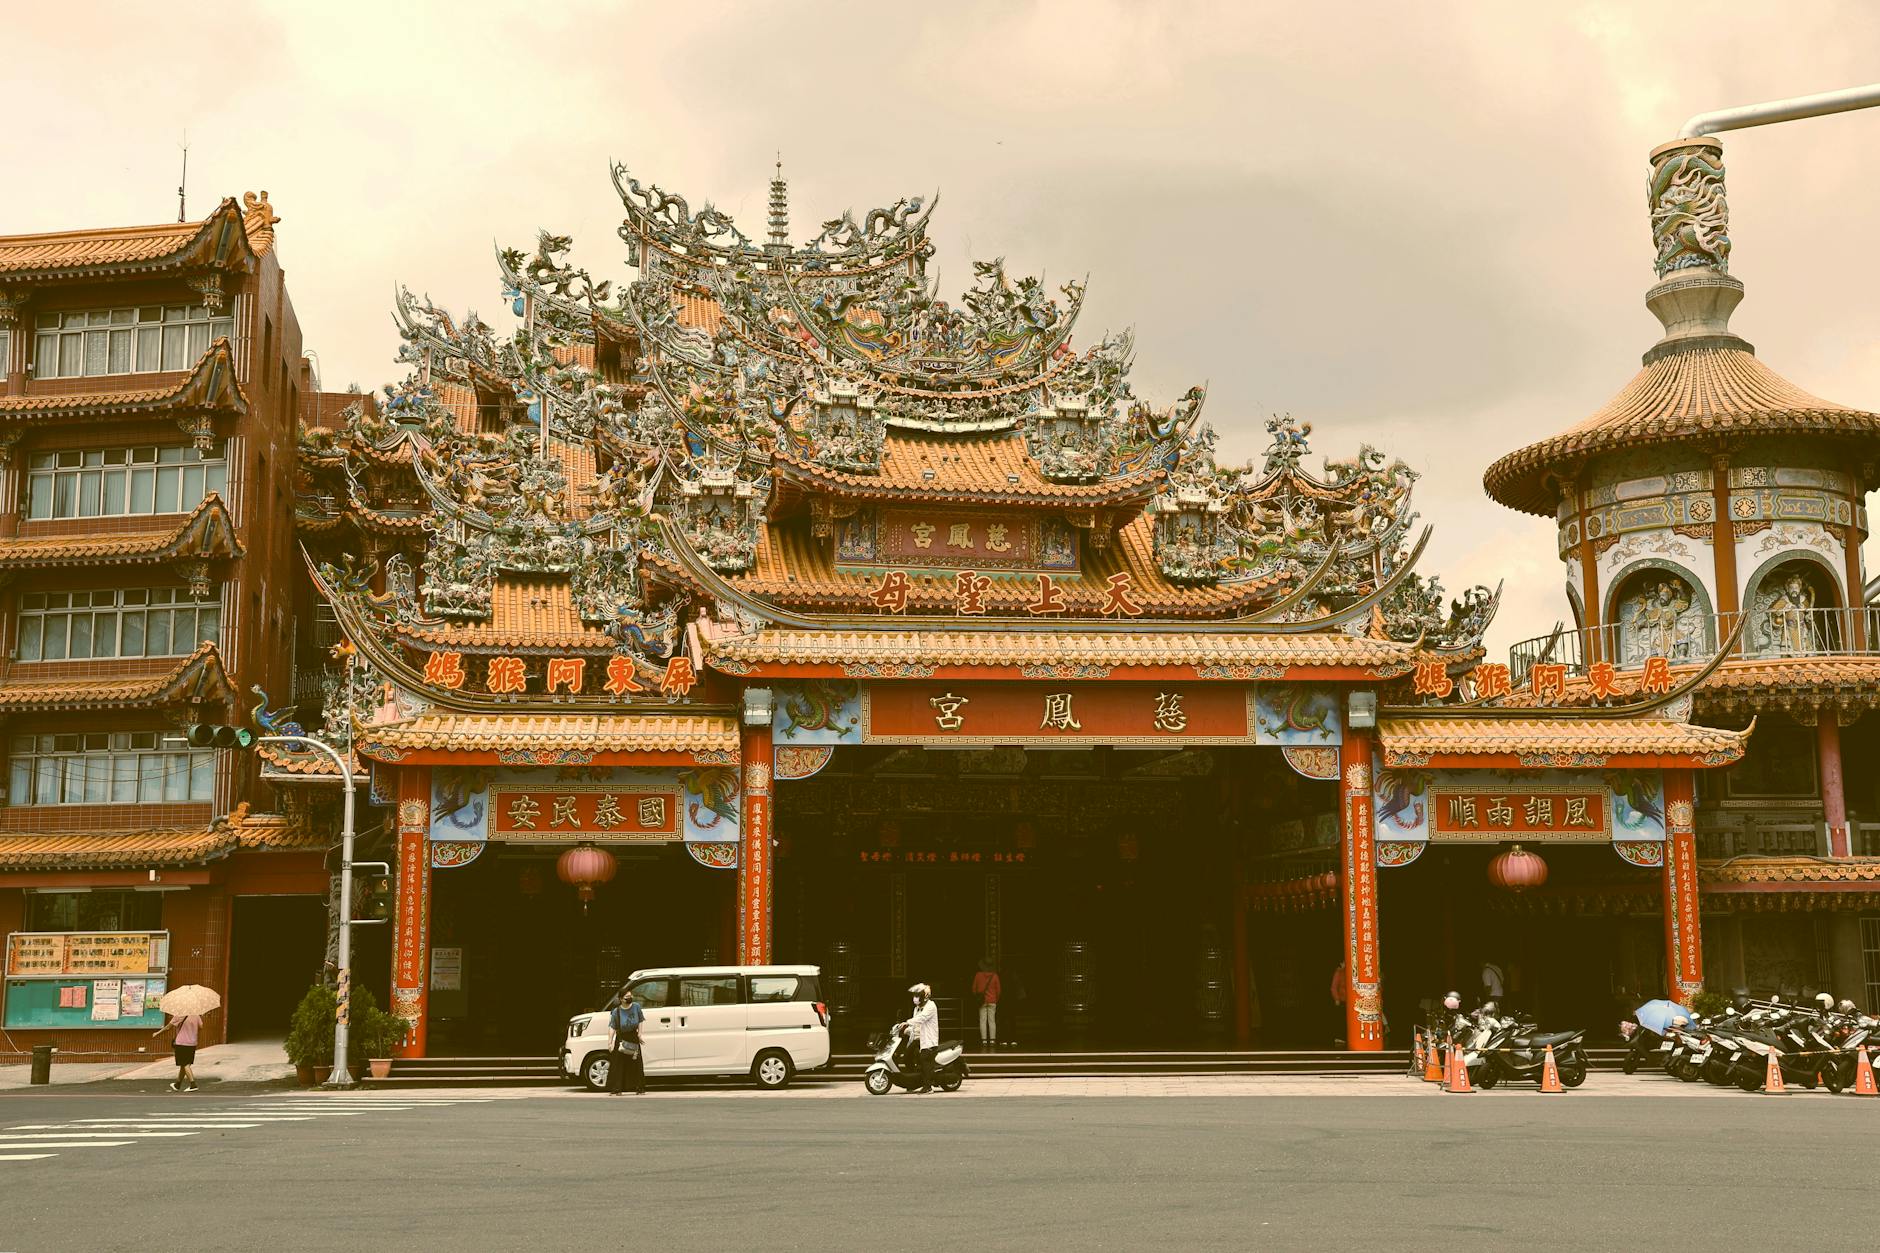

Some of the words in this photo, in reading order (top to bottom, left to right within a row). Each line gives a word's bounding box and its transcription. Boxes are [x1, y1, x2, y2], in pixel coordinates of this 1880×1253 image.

[911, 521, 1012, 552] 慈鳳宮
[869, 570, 1143, 615] 天上聖母
[422, 651, 697, 695] 屏東阿猴媽
[1413, 657, 1676, 700] 屏東阿猴媽
[929, 692, 1187, 732] 慈鳳宮
[507, 794, 666, 830] 國泰民安
[1448, 797, 1595, 829] 風調雨順
